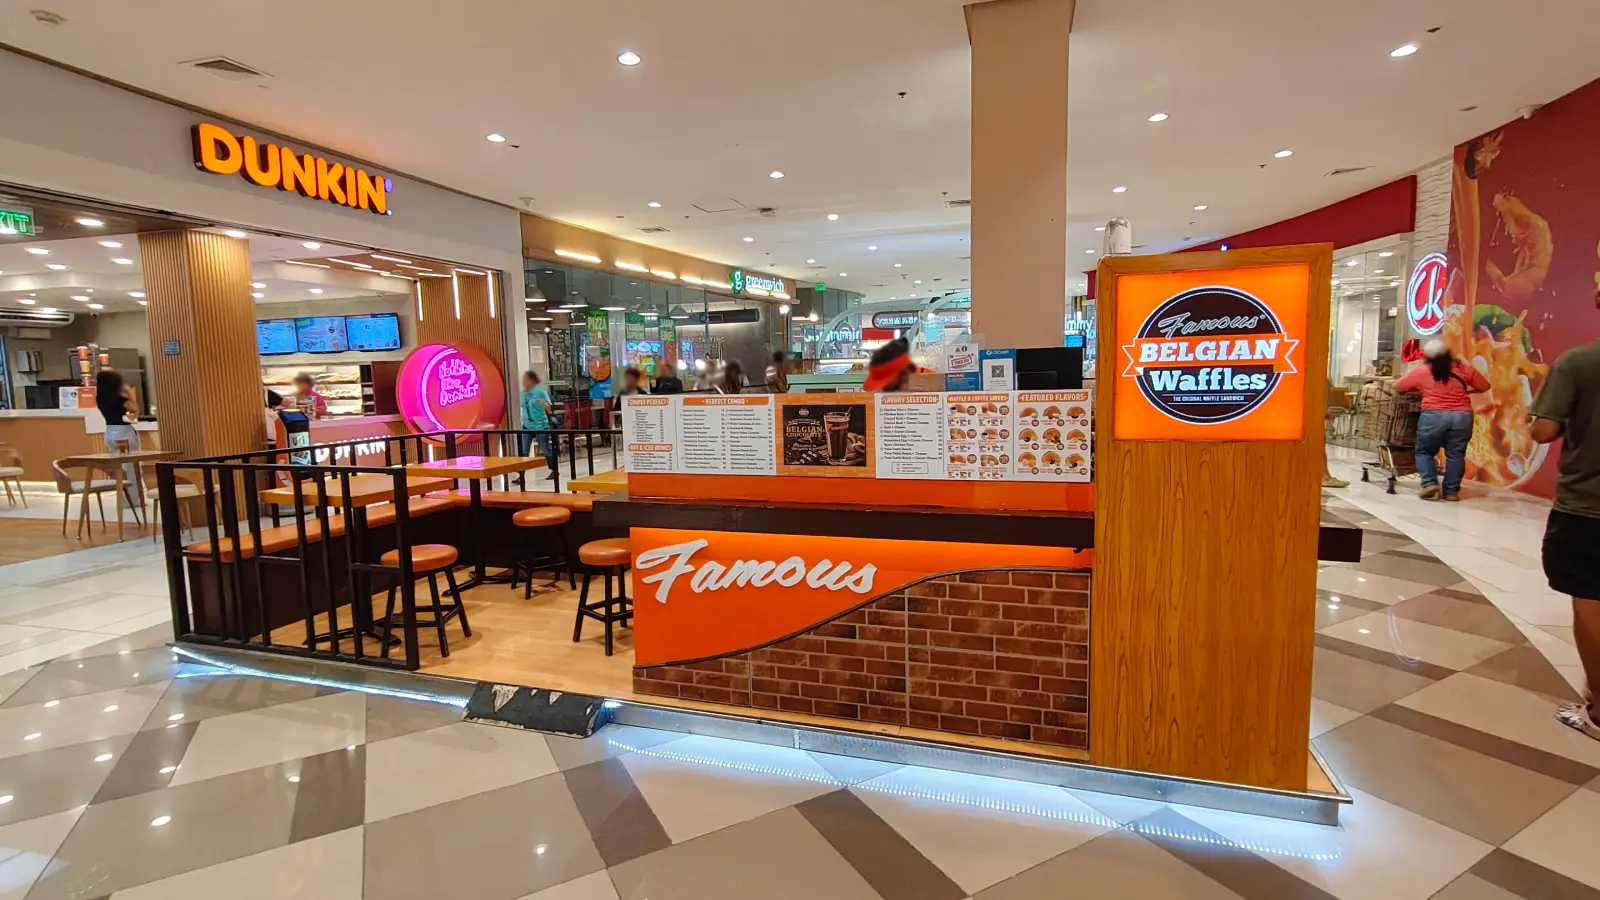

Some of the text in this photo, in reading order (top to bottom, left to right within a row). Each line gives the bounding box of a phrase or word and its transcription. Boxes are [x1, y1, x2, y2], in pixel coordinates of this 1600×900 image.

[192, 122, 393, 215] DUNKIN'
[745, 275, 785, 292] greenwich
[587, 316, 607, 330] PIZZA
[1139, 338, 1280, 363] BELGIAN
[1149, 369, 1267, 391] Waffles
[906, 395, 937, 403] SELECTION
[635, 538, 878, 604] Famous
